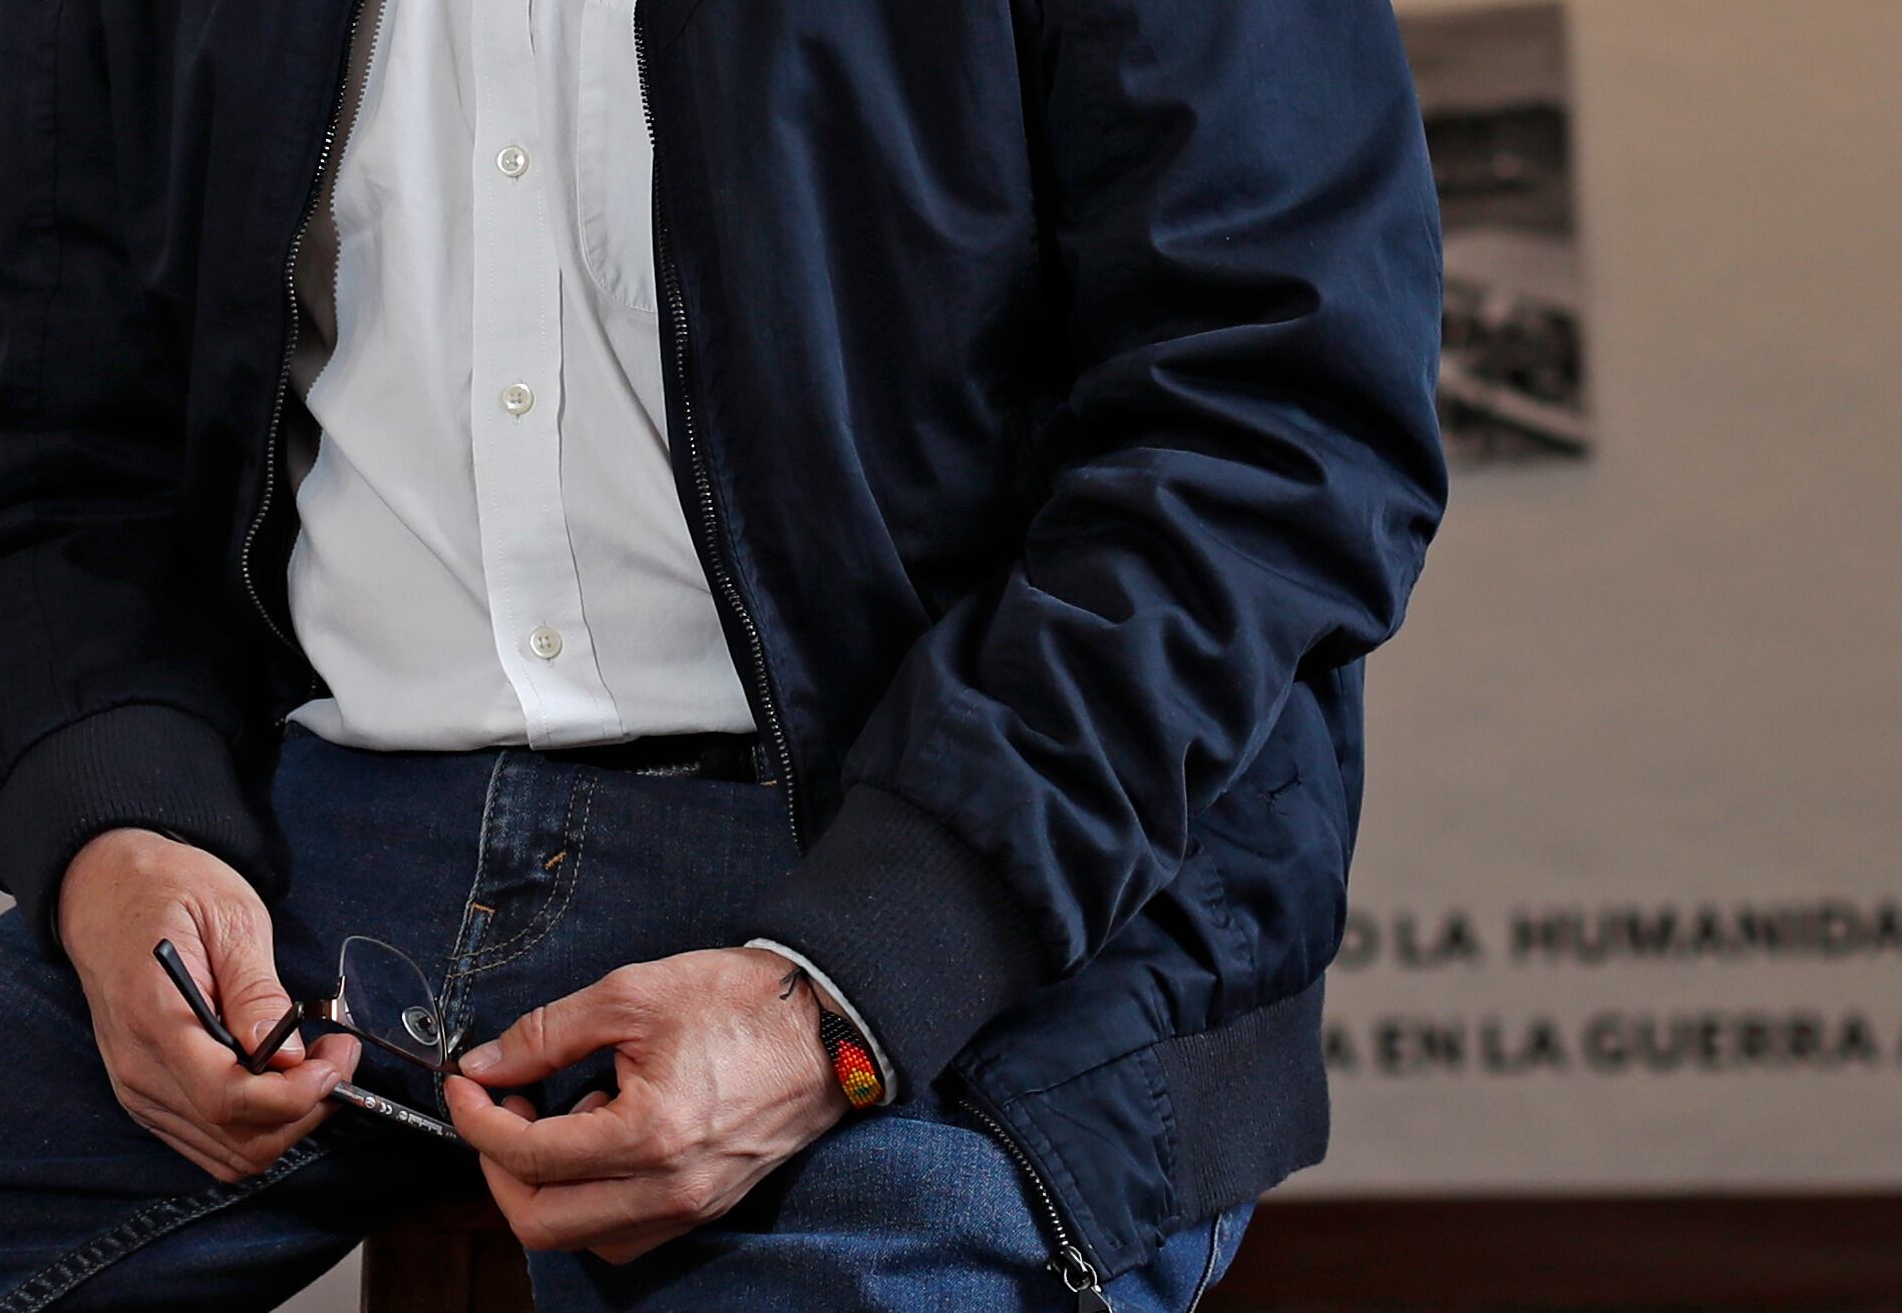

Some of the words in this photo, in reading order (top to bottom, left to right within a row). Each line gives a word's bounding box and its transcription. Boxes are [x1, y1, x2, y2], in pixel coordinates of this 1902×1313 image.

[1393, 908, 1484, 968] LA
[1373, 1017, 1466, 1075] EN
[1479, 1015, 1569, 1074] LA
[1583, 1009, 1882, 1073] GUERRA
